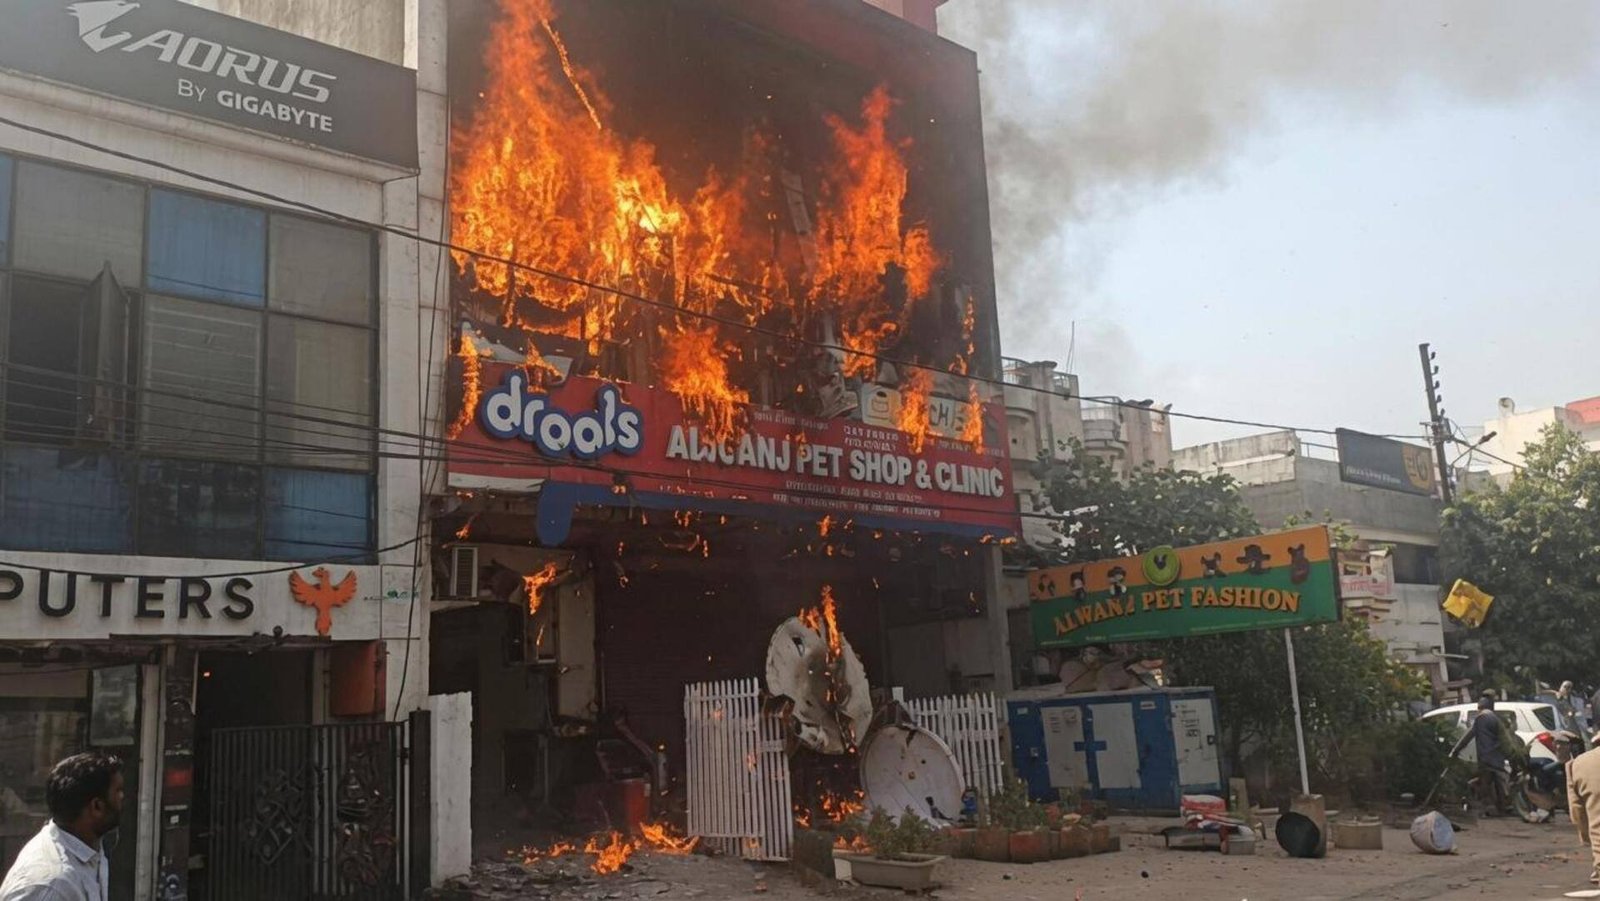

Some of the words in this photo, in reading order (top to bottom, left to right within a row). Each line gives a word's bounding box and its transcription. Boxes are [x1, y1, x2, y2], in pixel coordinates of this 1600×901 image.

[121, 29, 337, 103] AORUS
[216, 90, 333, 132] GIGABYTE
[486, 375, 640, 453] drools
[796, 443, 843, 478] PET
[850, 449, 912, 486] SHOP
[915, 459, 932, 490] &
[935, 462, 1005, 497] CLINIC
[1142, 588, 1185, 611] PET
[1191, 586, 1300, 613] FASHION
